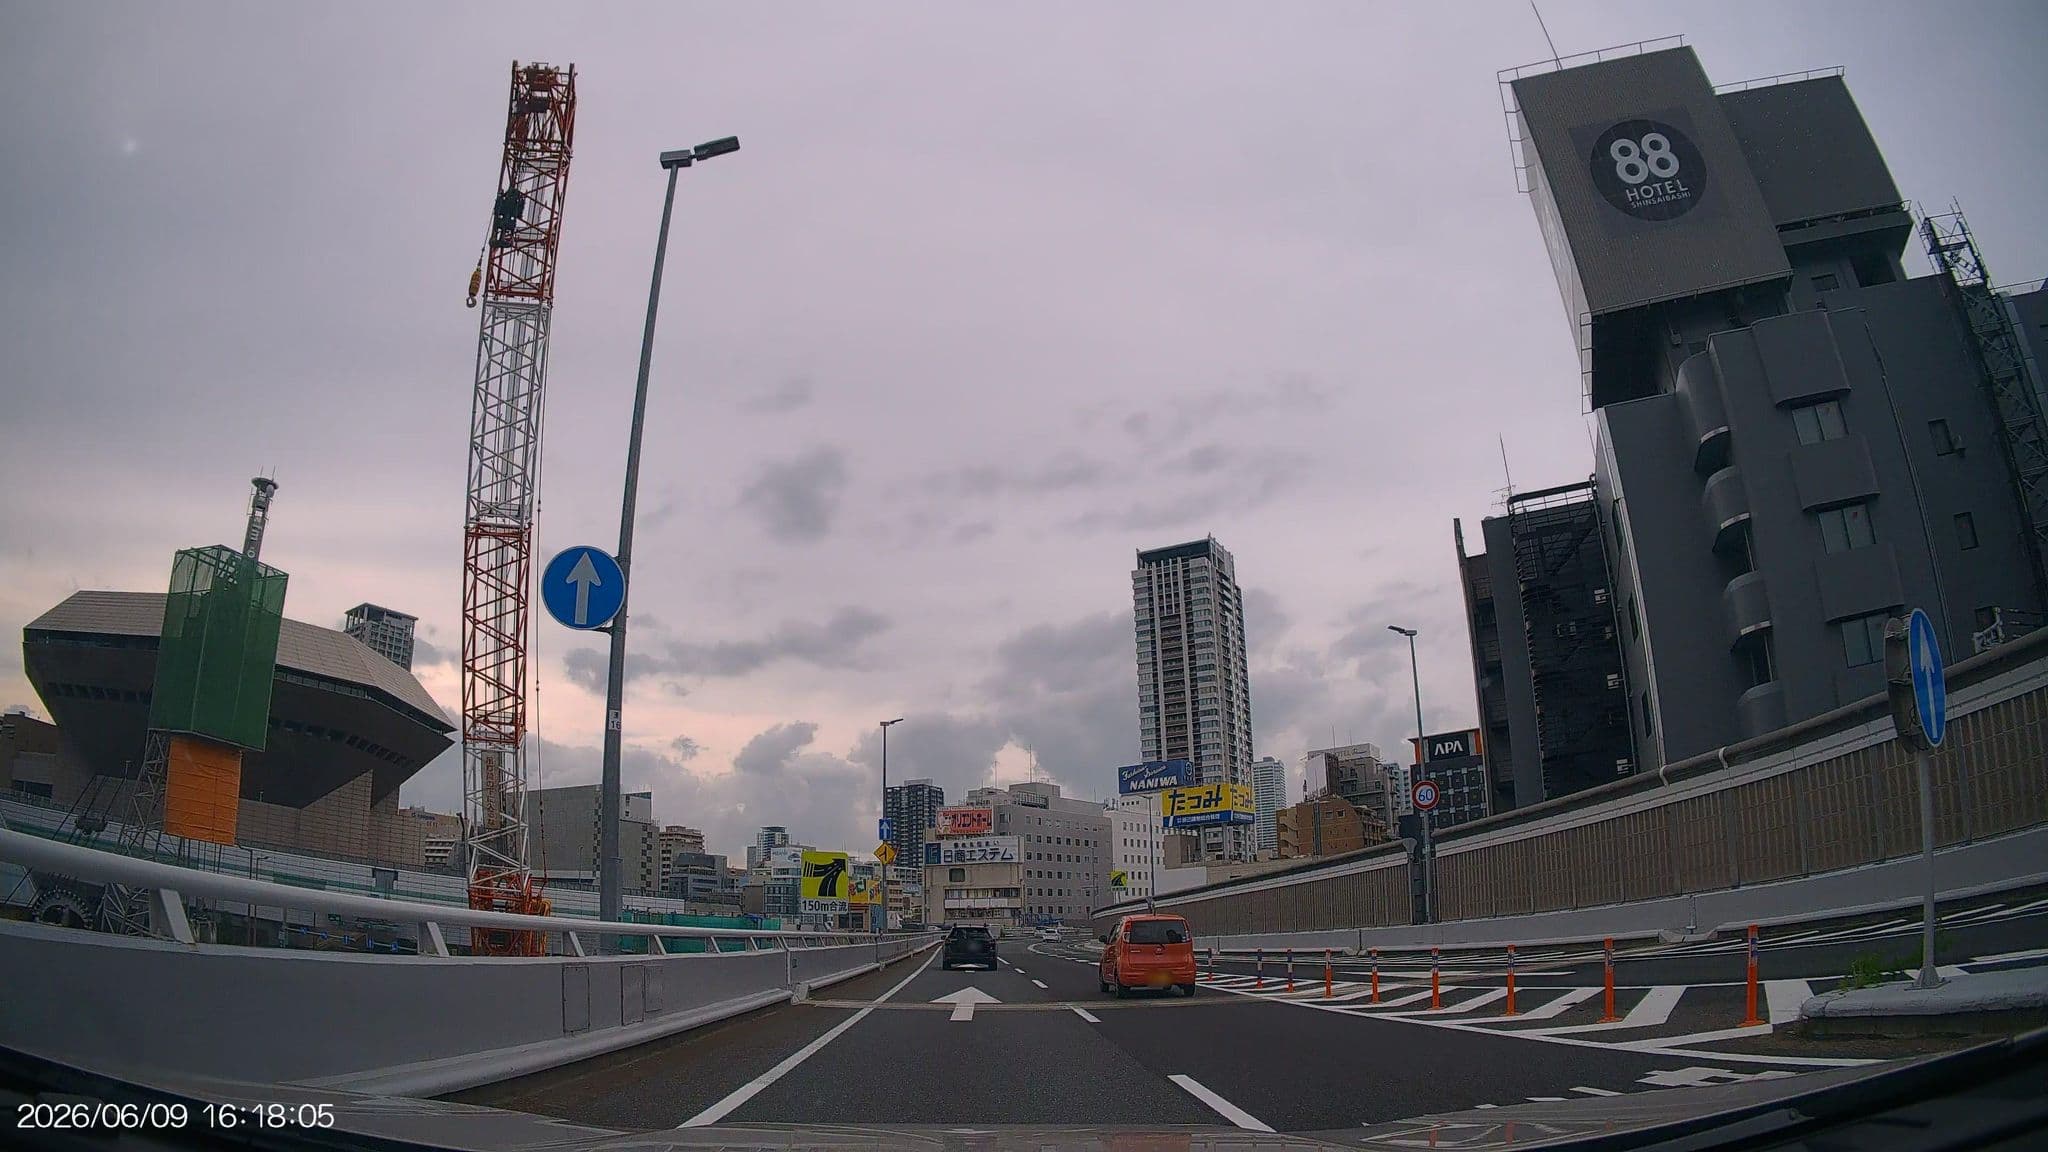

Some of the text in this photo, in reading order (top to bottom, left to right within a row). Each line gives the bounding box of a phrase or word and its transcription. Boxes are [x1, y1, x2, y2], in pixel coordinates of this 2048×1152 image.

[1610, 132, 1680, 185] 88
[1625, 179, 1689, 202] HOTEL
[1631, 192, 1691, 209] SHINSAIBASHI
[1434, 740, 1463, 756] APA
[1130, 775, 1178, 791] NANIWA
[1168, 785, 1222, 818] たつみ
[1418, 788, 1433, 802] 60
[943, 847, 1014, 863] 日商エステム
[802, 900, 847, 912] 150m合流
